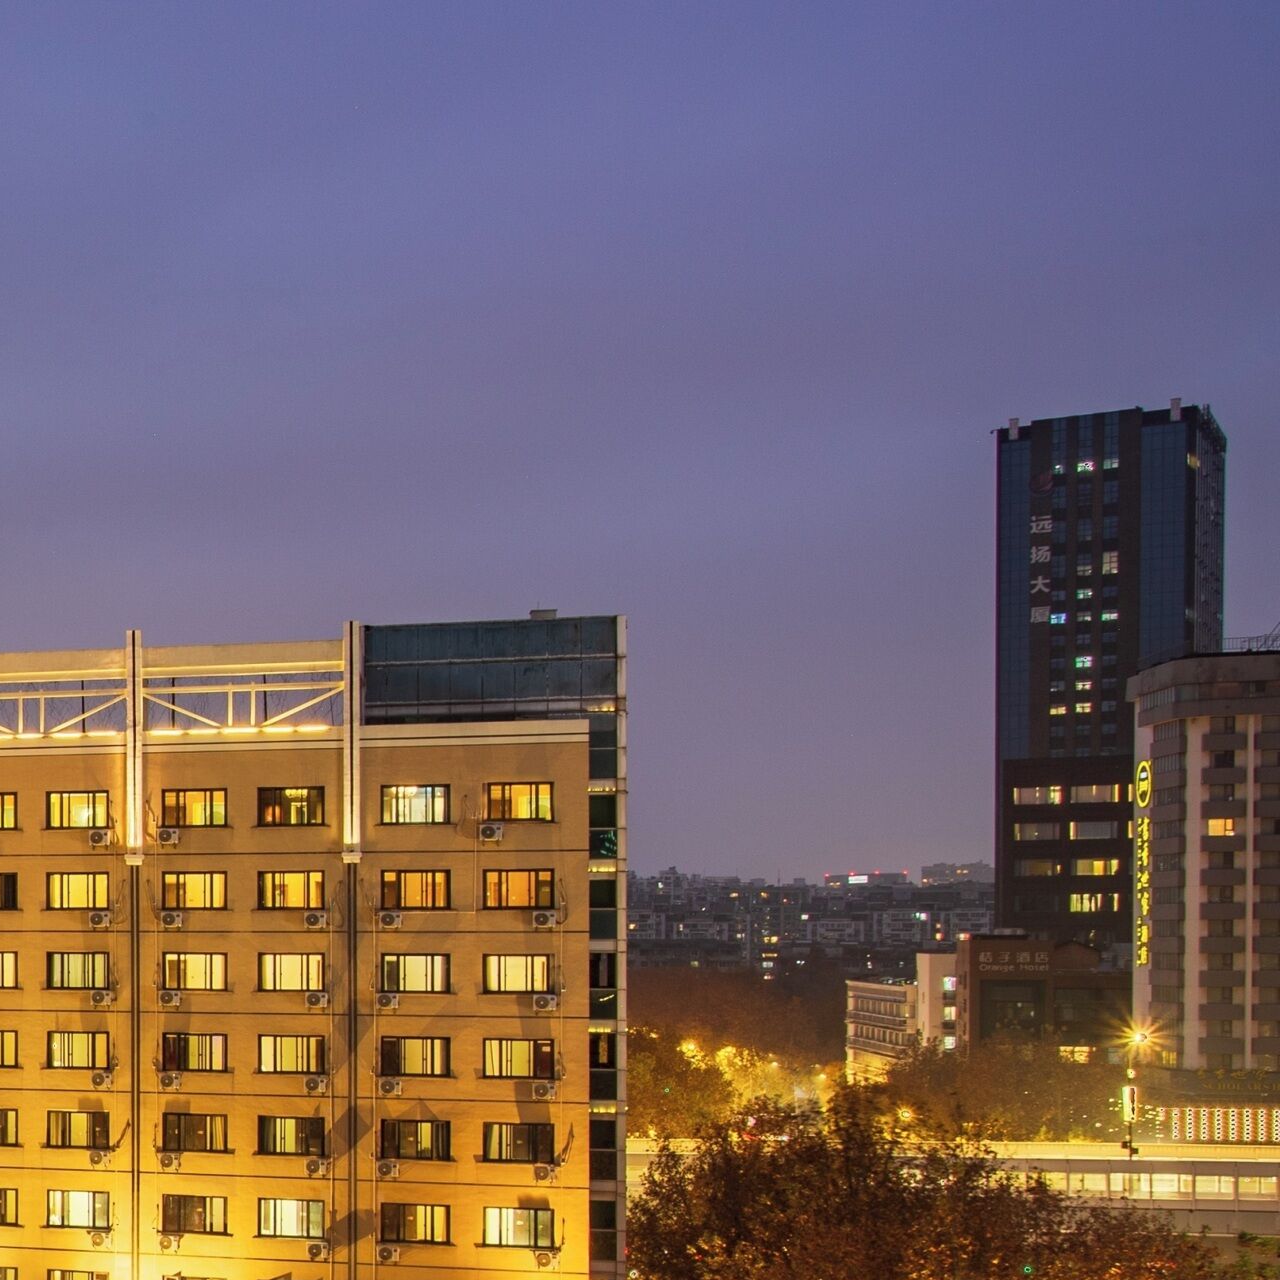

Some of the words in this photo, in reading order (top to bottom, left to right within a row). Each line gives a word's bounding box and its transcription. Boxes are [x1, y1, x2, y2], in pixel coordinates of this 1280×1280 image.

[1030, 515, 1053, 623] 远扬大厦
[979, 963, 1016, 973] Orange
[1019, 963, 1049, 972] Hotel
